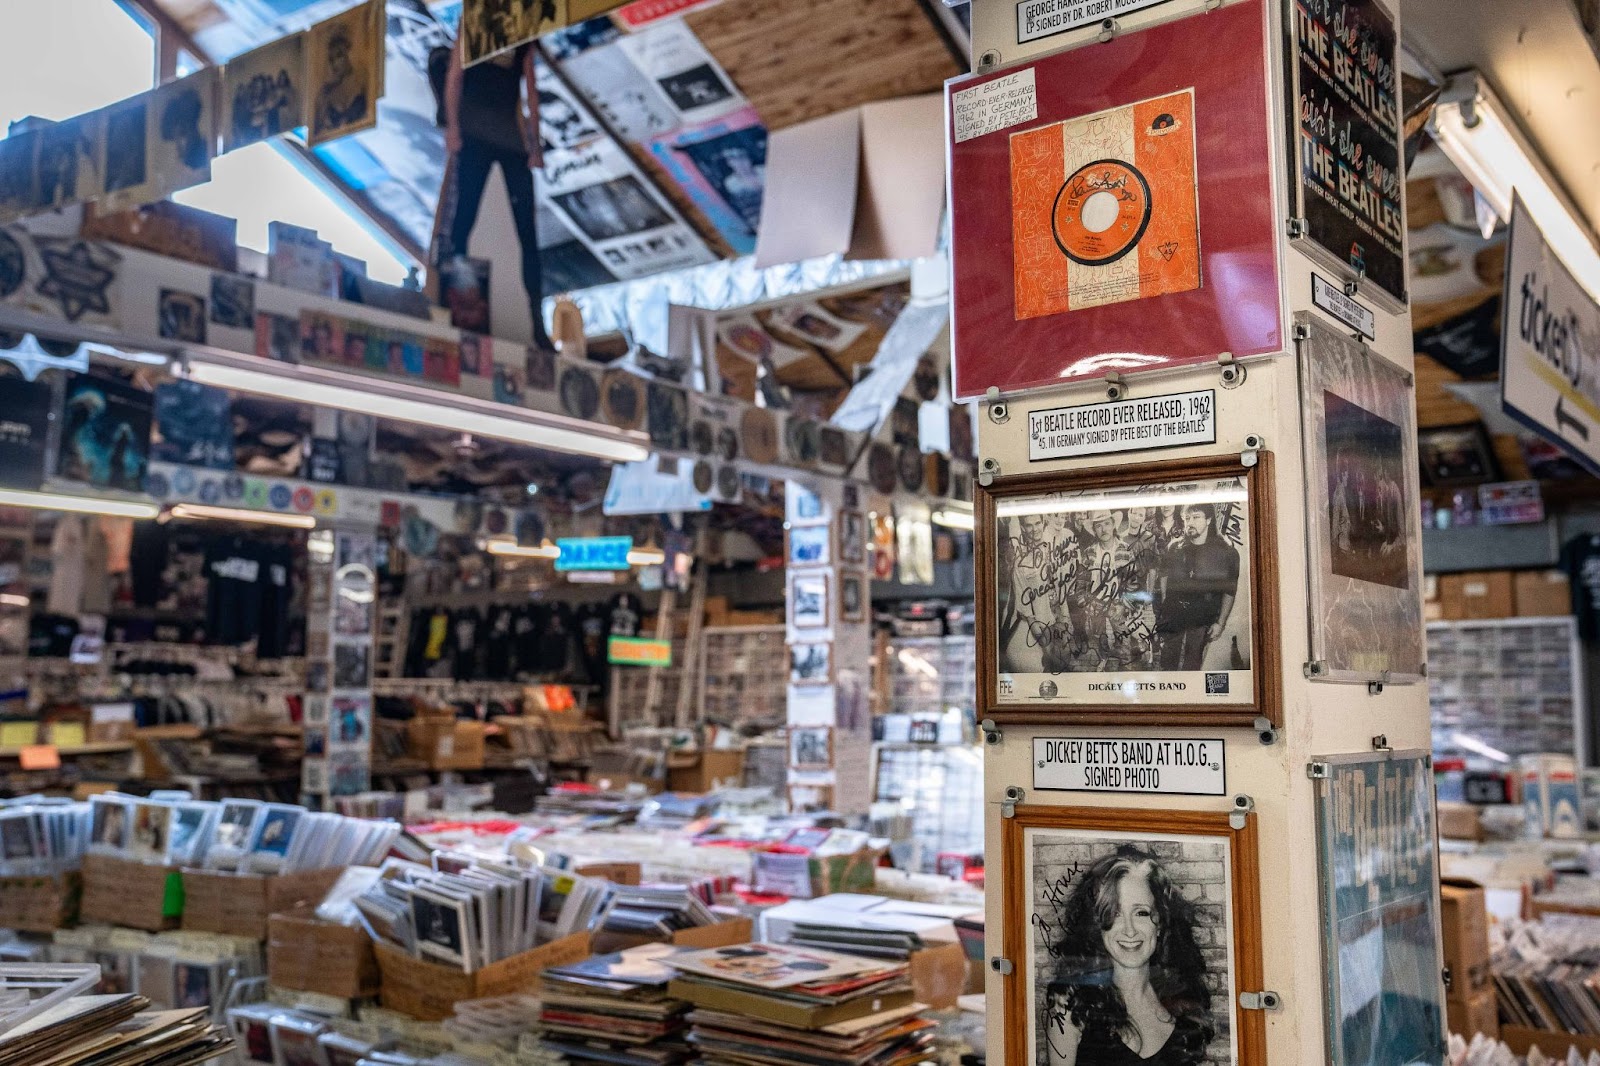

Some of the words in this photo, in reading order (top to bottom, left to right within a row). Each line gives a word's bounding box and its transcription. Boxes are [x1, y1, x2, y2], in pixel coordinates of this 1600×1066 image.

[1026, 0, 1055, 18] GEORGE
[1026, 22, 1035, 34] LP
[1036, 14, 1061, 32] SIGNED
[1062, 10, 1072, 24] BY
[1073, 8, 1085, 20] DR.
[1086, 0, 1113, 16] ROBERT
[1297, 3, 1330, 68] THE
[1333, 42, 1397, 133] BEATLES
[956, 88, 978, 102] FIRST
[983, 75, 1019, 94] BEATLE
[956, 98, 986, 114] RECORD
[988, 93, 1006, 105] EVER
[978, 108, 986, 118] IN
[991, 94, 1032, 114] GERMANY
[957, 119, 986, 134] SIGNED
[988, 115, 998, 126] BY
[1000, 109, 1018, 122] PETE
[1018, 103, 1036, 116] BEST
[1301, 126, 1336, 191] THE
[1338, 160, 1402, 242] BEATLES
[1308, 178, 1324, 197] OTHER
[1032, 416, 1042, 434] 1st
[1044, 412, 1074, 432] BEATLE
[1077, 408, 1110, 428] RECORD
[1114, 404, 1134, 424] EVER
[1138, 400, 1186, 422] RELEASED;
[1189, 396, 1210, 416] 1962
[1048, 436, 1055, 448] IN
[1056, 432, 1085, 448] GERMANY
[1086, 430, 1109, 444] SIGNED
[1111, 429, 1118, 442] BY
[1120, 426, 1136, 440] PETE
[1137, 424, 1152, 438] BEST
[1154, 424, 1162, 438] OF
[1164, 422, 1176, 436] THE
[1178, 419, 1206, 434] BEATLES
[1088, 682, 1122, 690] DICKEY
[1125, 682, 1156, 690] ETTS
[1159, 682, 1186, 690] BAND
[1046, 741, 1082, 764] DICKEY
[1086, 742, 1118, 764] BETTS
[1122, 742, 1152, 765] BAND
[1156, 743, 1171, 766] AT
[1174, 743, 1211, 766] H.O.G.
[1084, 766, 1122, 788] SIGNED
[1124, 768, 1160, 788] PHOTO
